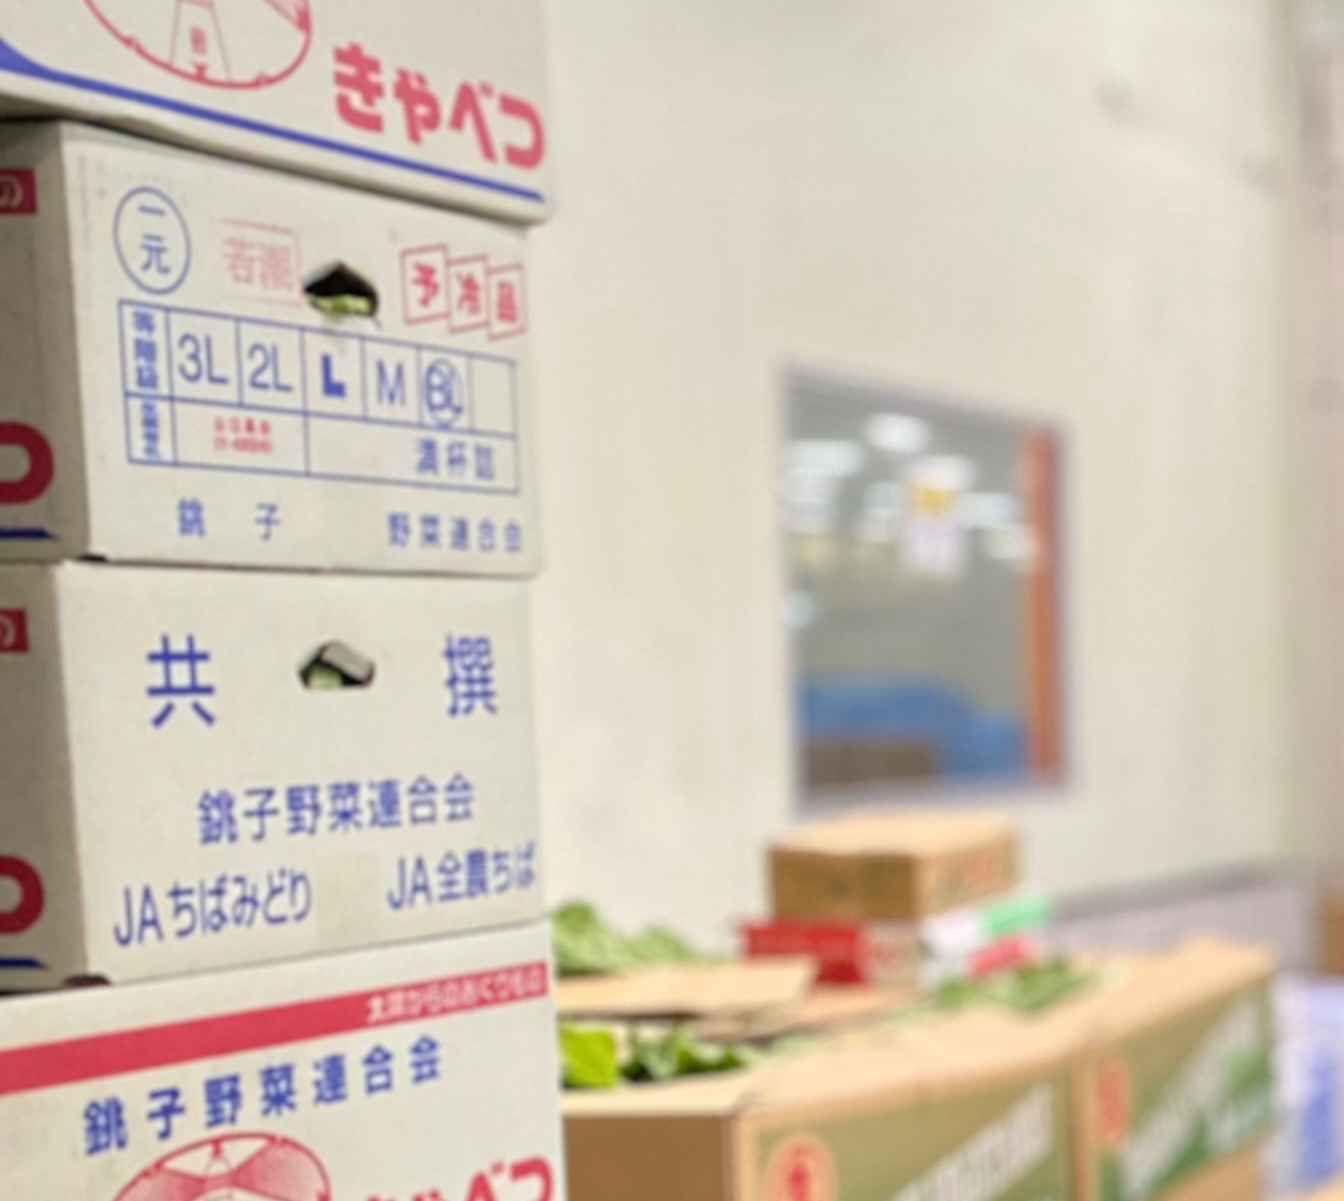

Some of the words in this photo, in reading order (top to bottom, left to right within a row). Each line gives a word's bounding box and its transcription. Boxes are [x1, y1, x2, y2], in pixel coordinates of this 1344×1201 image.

[177, 333, 230, 384] 3L
[247, 342, 294, 393] 2L
[321, 353, 346, 398] L
[376, 358, 406, 406] M
[197, 773, 474, 845] 銚子野菜連合会
[82, 1035, 442, 1156] 銚子野菜連合会
